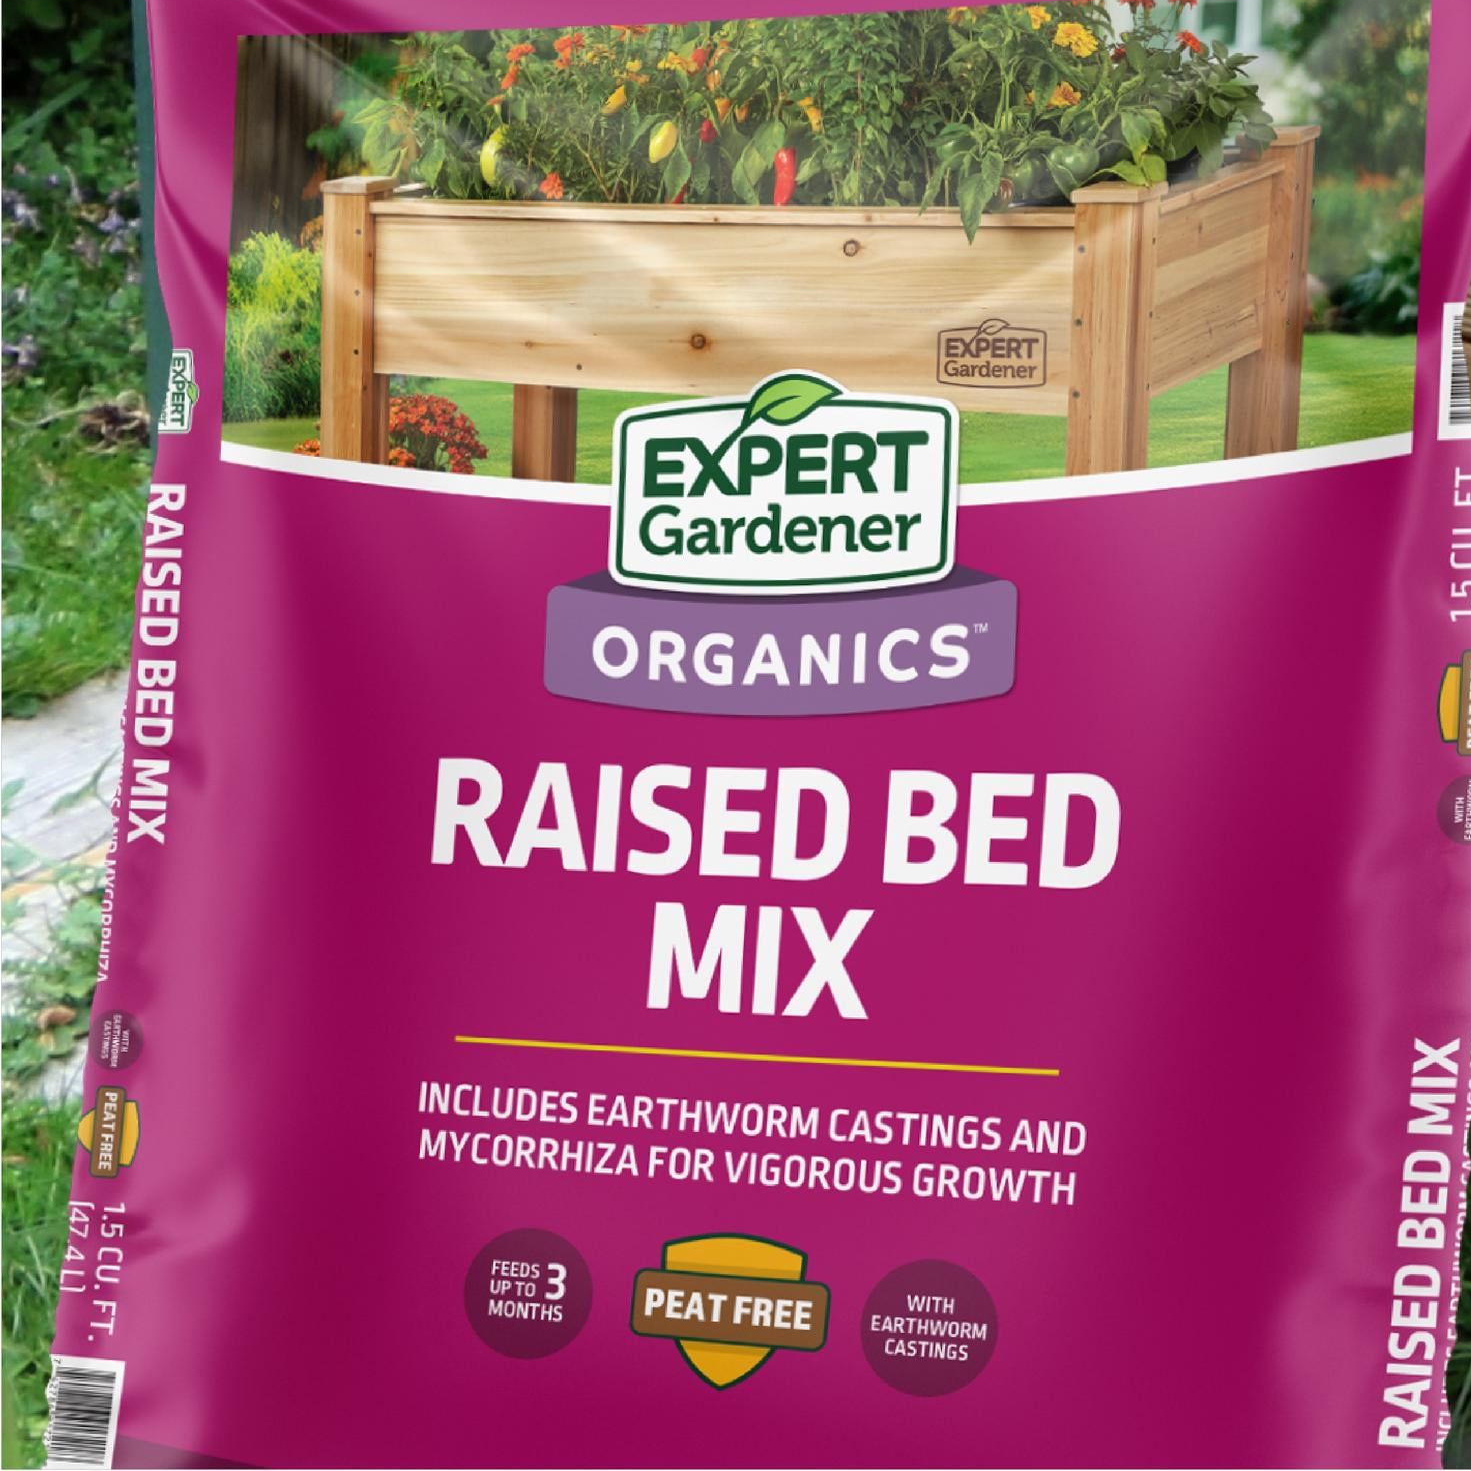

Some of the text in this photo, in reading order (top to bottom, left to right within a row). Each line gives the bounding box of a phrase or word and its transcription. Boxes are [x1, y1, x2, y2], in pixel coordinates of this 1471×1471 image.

[944, 337, 1039, 359] EXPERT
[944, 360, 1037, 379] Gardener
[171, 356, 187, 427] EXPERT
[642, 430, 930, 498] EXPERT
[639, 503, 921, 556] Gardener
[127, 484, 187, 845] RAISED BED MIX
[592, 624, 970, 686] ORGANICS
[431, 757, 1121, 889] RAISED BED
[1454, 797, 1465, 824] WITH
[646, 901, 875, 1020] MIX
[120, 1029, 130, 1053] WITH
[98, 1091, 118, 1170] PEAT FREE
[418, 1081, 1087, 1156] INCLUDES EARTHWORM CASTINGS AND
[418, 1128, 1076, 1206] MYCORRHIZA FOR VIGOROUS GROWTH
[1378, 1037, 1460, 1449] RAISED BED MIX
[87, 1202, 126, 1341] 1.5 CU. FT.
[490, 1279, 536, 1297] UP TO
[491, 1260, 540, 1279] FEEDS
[545, 1263, 567, 1300] 3
[488, 1299, 563, 1322] MONTHS
[644, 1287, 813, 1331] PEAT FREE
[871, 1314, 988, 1340] EARTHWORM
[907, 1294, 955, 1314] WITH
[884, 1339, 969, 1361] CASTINGS
